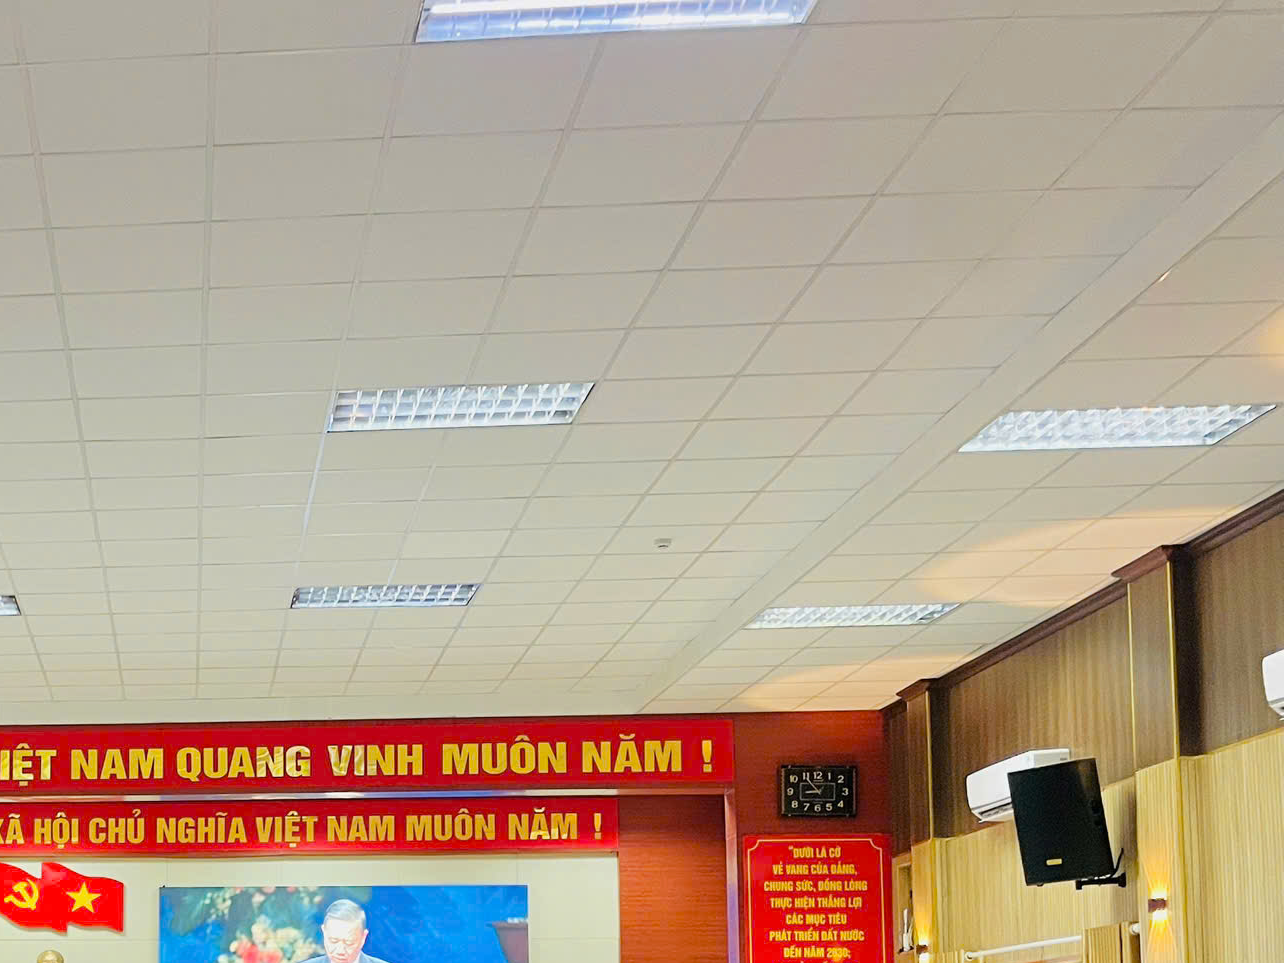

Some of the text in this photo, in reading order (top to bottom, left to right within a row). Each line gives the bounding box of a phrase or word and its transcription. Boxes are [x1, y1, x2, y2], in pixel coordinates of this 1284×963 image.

[70, 748, 164, 780] NAM
[177, 746, 310, 781] QUANG
[327, 744, 423, 776] VINH
[442, 735, 567, 775] MUÔN
[582, 734, 682, 772] NĂM
[789, 775, 798, 783] 10
[33, 811, 79, 849] HỘI
[89, 809, 145, 844] CHỦ
[156, 812, 244, 844] NGHĨA
[255, 811, 318, 848] VIỆT
[327, 815, 395, 843] NAM
[406, 808, 495, 842] MUÔN
[508, 807, 578, 841] NĂM
